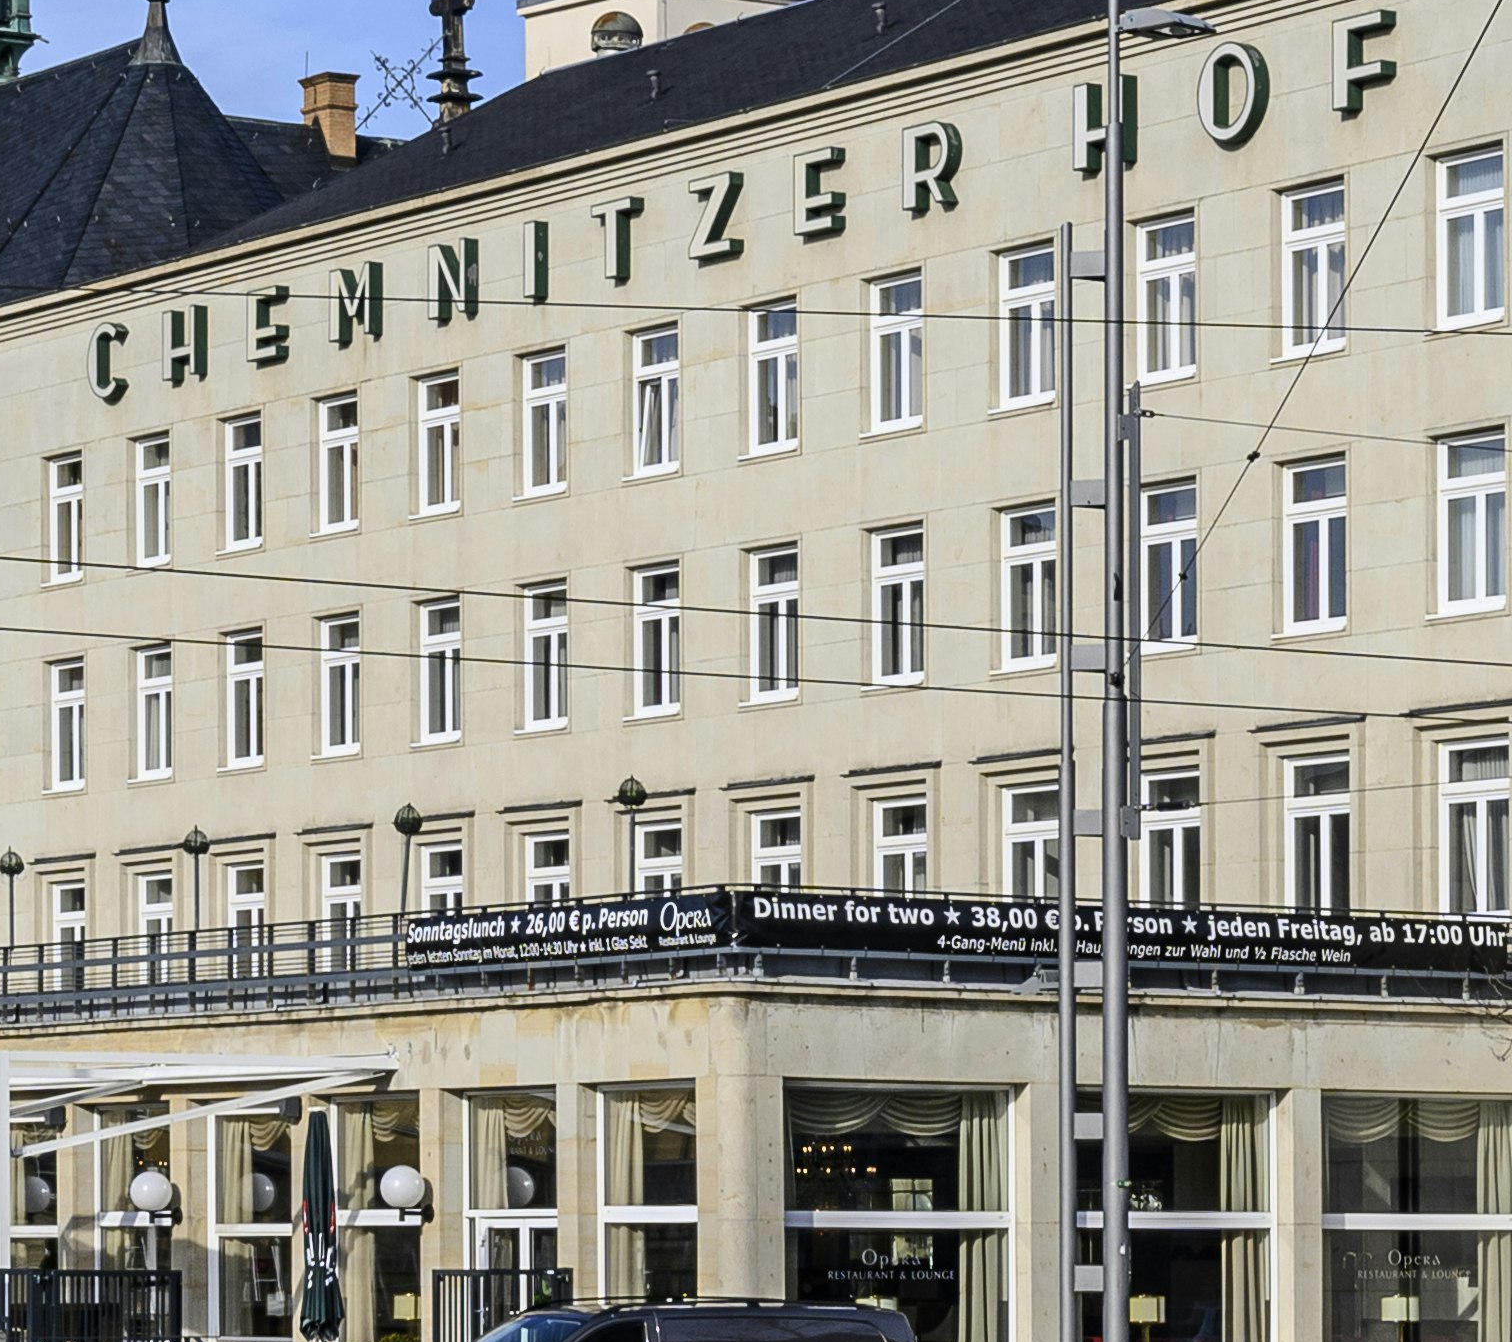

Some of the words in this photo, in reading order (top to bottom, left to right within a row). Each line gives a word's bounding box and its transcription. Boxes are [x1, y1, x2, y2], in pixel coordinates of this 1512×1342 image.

[87, 121, 963, 405] CHEMNITZER
[1073, 9, 1398, 176] HOF
[407, 915, 505, 944] Sonntagslunch
[525, 911, 565, 937] 26,00
[569, 910, 581, 931] €
[599, 908, 649, 929] Person
[754, 897, 837, 921] Dinner
[844, 900, 881, 923] for
[888, 904, 934, 925] two
[971, 906, 1038, 933] 38,00
[1207, 914, 1270, 941] jeden
[1277, 919, 1363, 946] Freitag,
[1370, 922, 1395, 944] ab
[1402, 923, 1463, 946] 17:00
[1469, 925, 1506, 948] Uhr
[454, 947, 483, 963] Sonntag
[564, 940, 579, 954] Uhr
[937, 934, 1026, 953] 4-Gang-Menü
[1031, 938, 1058, 953] inkl.
[1165, 945, 1186, 957] zur
[1190, 943, 1221, 959] Wahl
[1225, 945, 1250, 959] und
[1271, 946, 1319, 961] Flasche
[1322, 947, 1351, 963] Wein
[827, 1270, 894, 1280] RESTAURANT
[899, 1270, 906, 1280] &
[911, 1270, 955, 1280] LOUNGE
[1357, 1269, 1417, 1279] RESTAURANT
